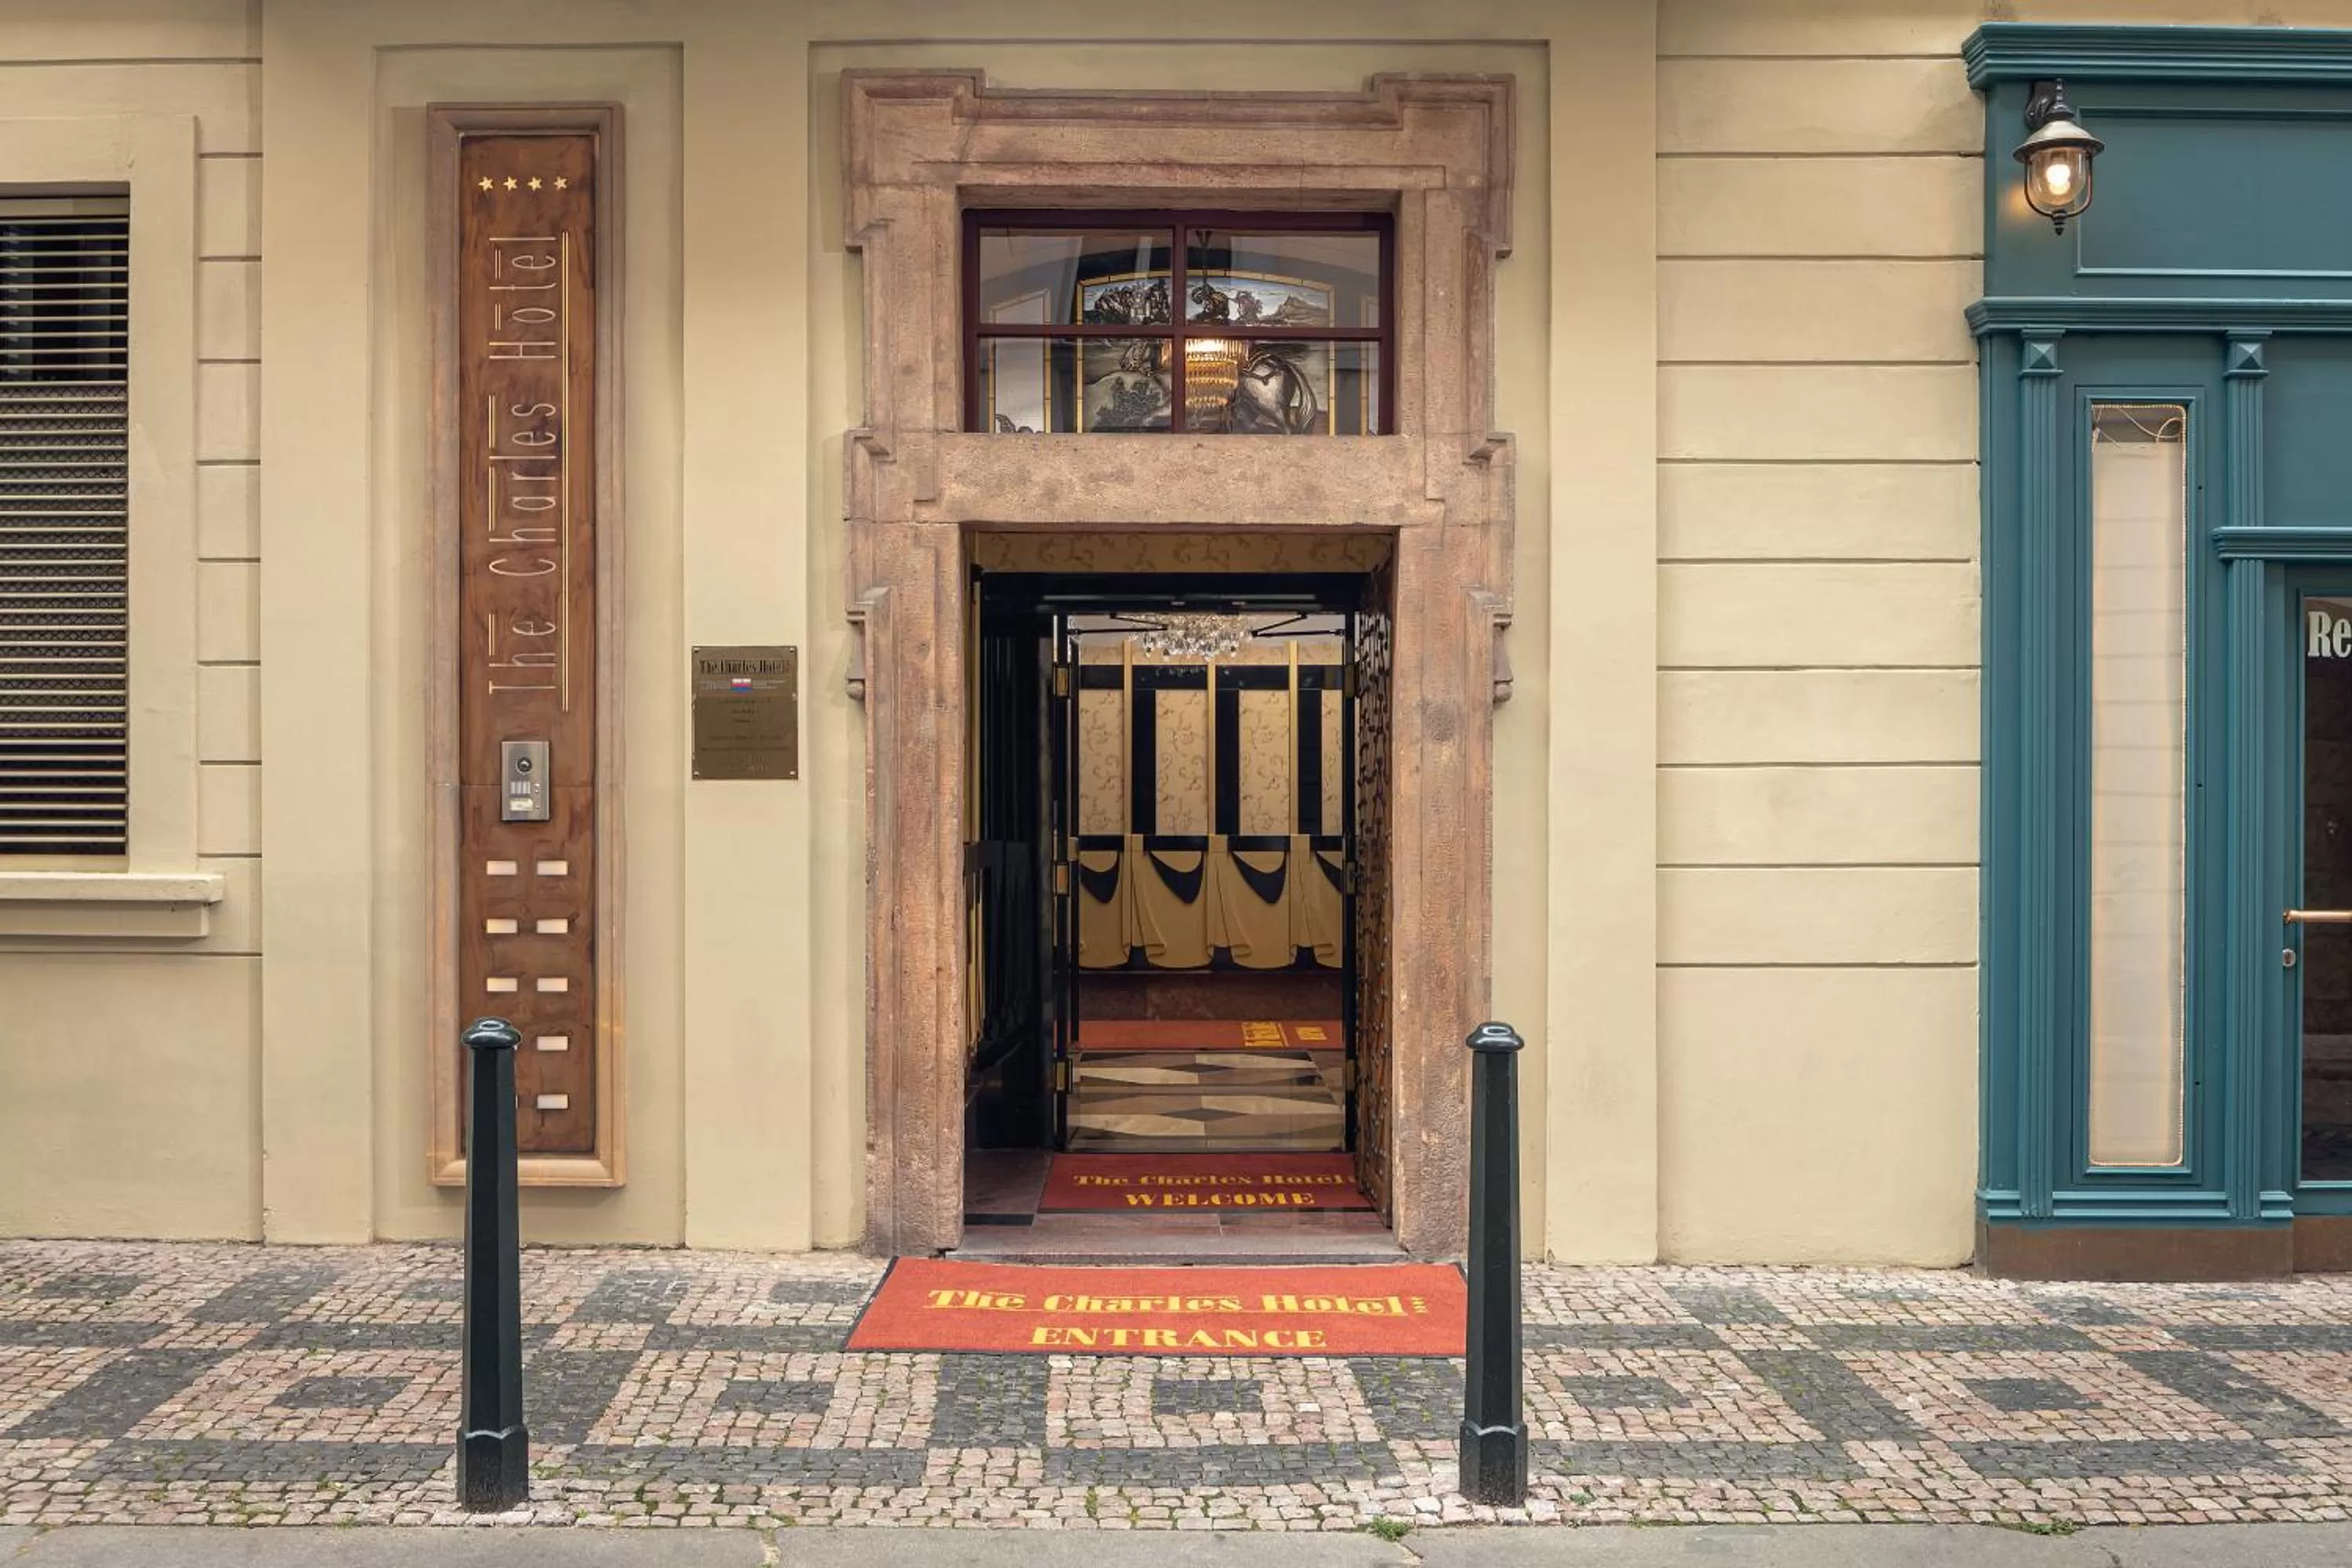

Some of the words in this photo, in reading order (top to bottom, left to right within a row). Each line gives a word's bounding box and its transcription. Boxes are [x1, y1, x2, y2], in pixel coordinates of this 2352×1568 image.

[488, 237, 557, 359] Hotel
[488, 399, 557, 576] Charles
[488, 615, 557, 695] The
[1074, 1175, 1129, 1185] The
[1140, 1175, 1252, 1185] Charles
[1261, 1175, 1345, 1185] Hotel
[1125, 1193, 1316, 1206] WELCOME
[928, 1290, 1025, 1308] The
[1044, 1295, 1242, 1312] Charles
[1261, 1294, 1408, 1316] Hotel
[1029, 1327, 1327, 1348] ENTRANCE
